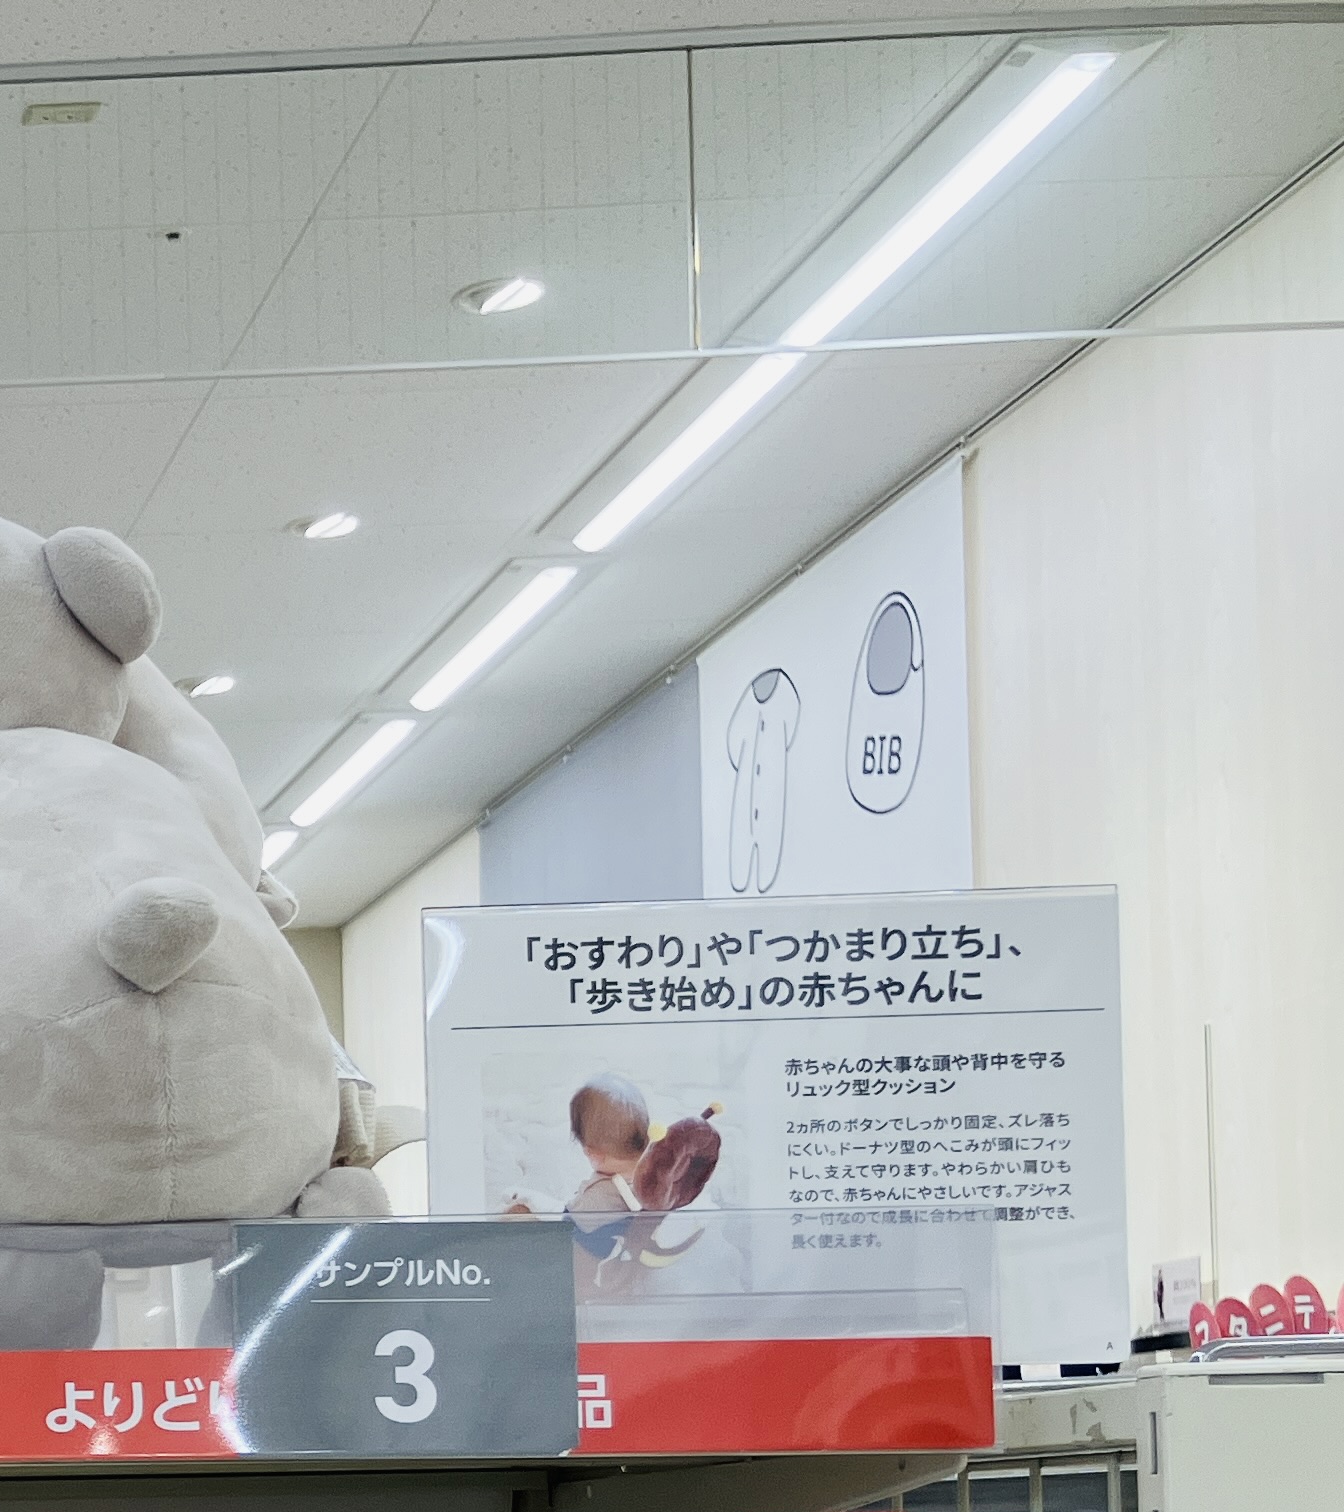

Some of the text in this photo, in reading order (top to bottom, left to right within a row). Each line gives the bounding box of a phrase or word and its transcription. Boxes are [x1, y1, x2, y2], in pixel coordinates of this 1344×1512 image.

[862, 736, 902, 775] BIB
[525, 925, 1023, 972] 「おすわり」や「つかまり立ち」、
[569, 969, 983, 1014] 「歩き始め」の赤ちゃんに
[785, 1052, 1066, 1076] 赤ちゃんの大事な頭や背中を守る
[787, 1078, 956, 1097] リュック型クッション
[787, 1137, 1071, 1157] にくい。ドーナツ型のへこみが頭にフィッ
[789, 1160, 1071, 1180] トし、支えて守ります。やわらかい肩ひも
[789, 1184, 1072, 1203] なので、赤ちゃんにやさしいです。アジャス
[314, 1258, 491, 1288] サンプルNo.
[374, 1329, 437, 1423] 3
